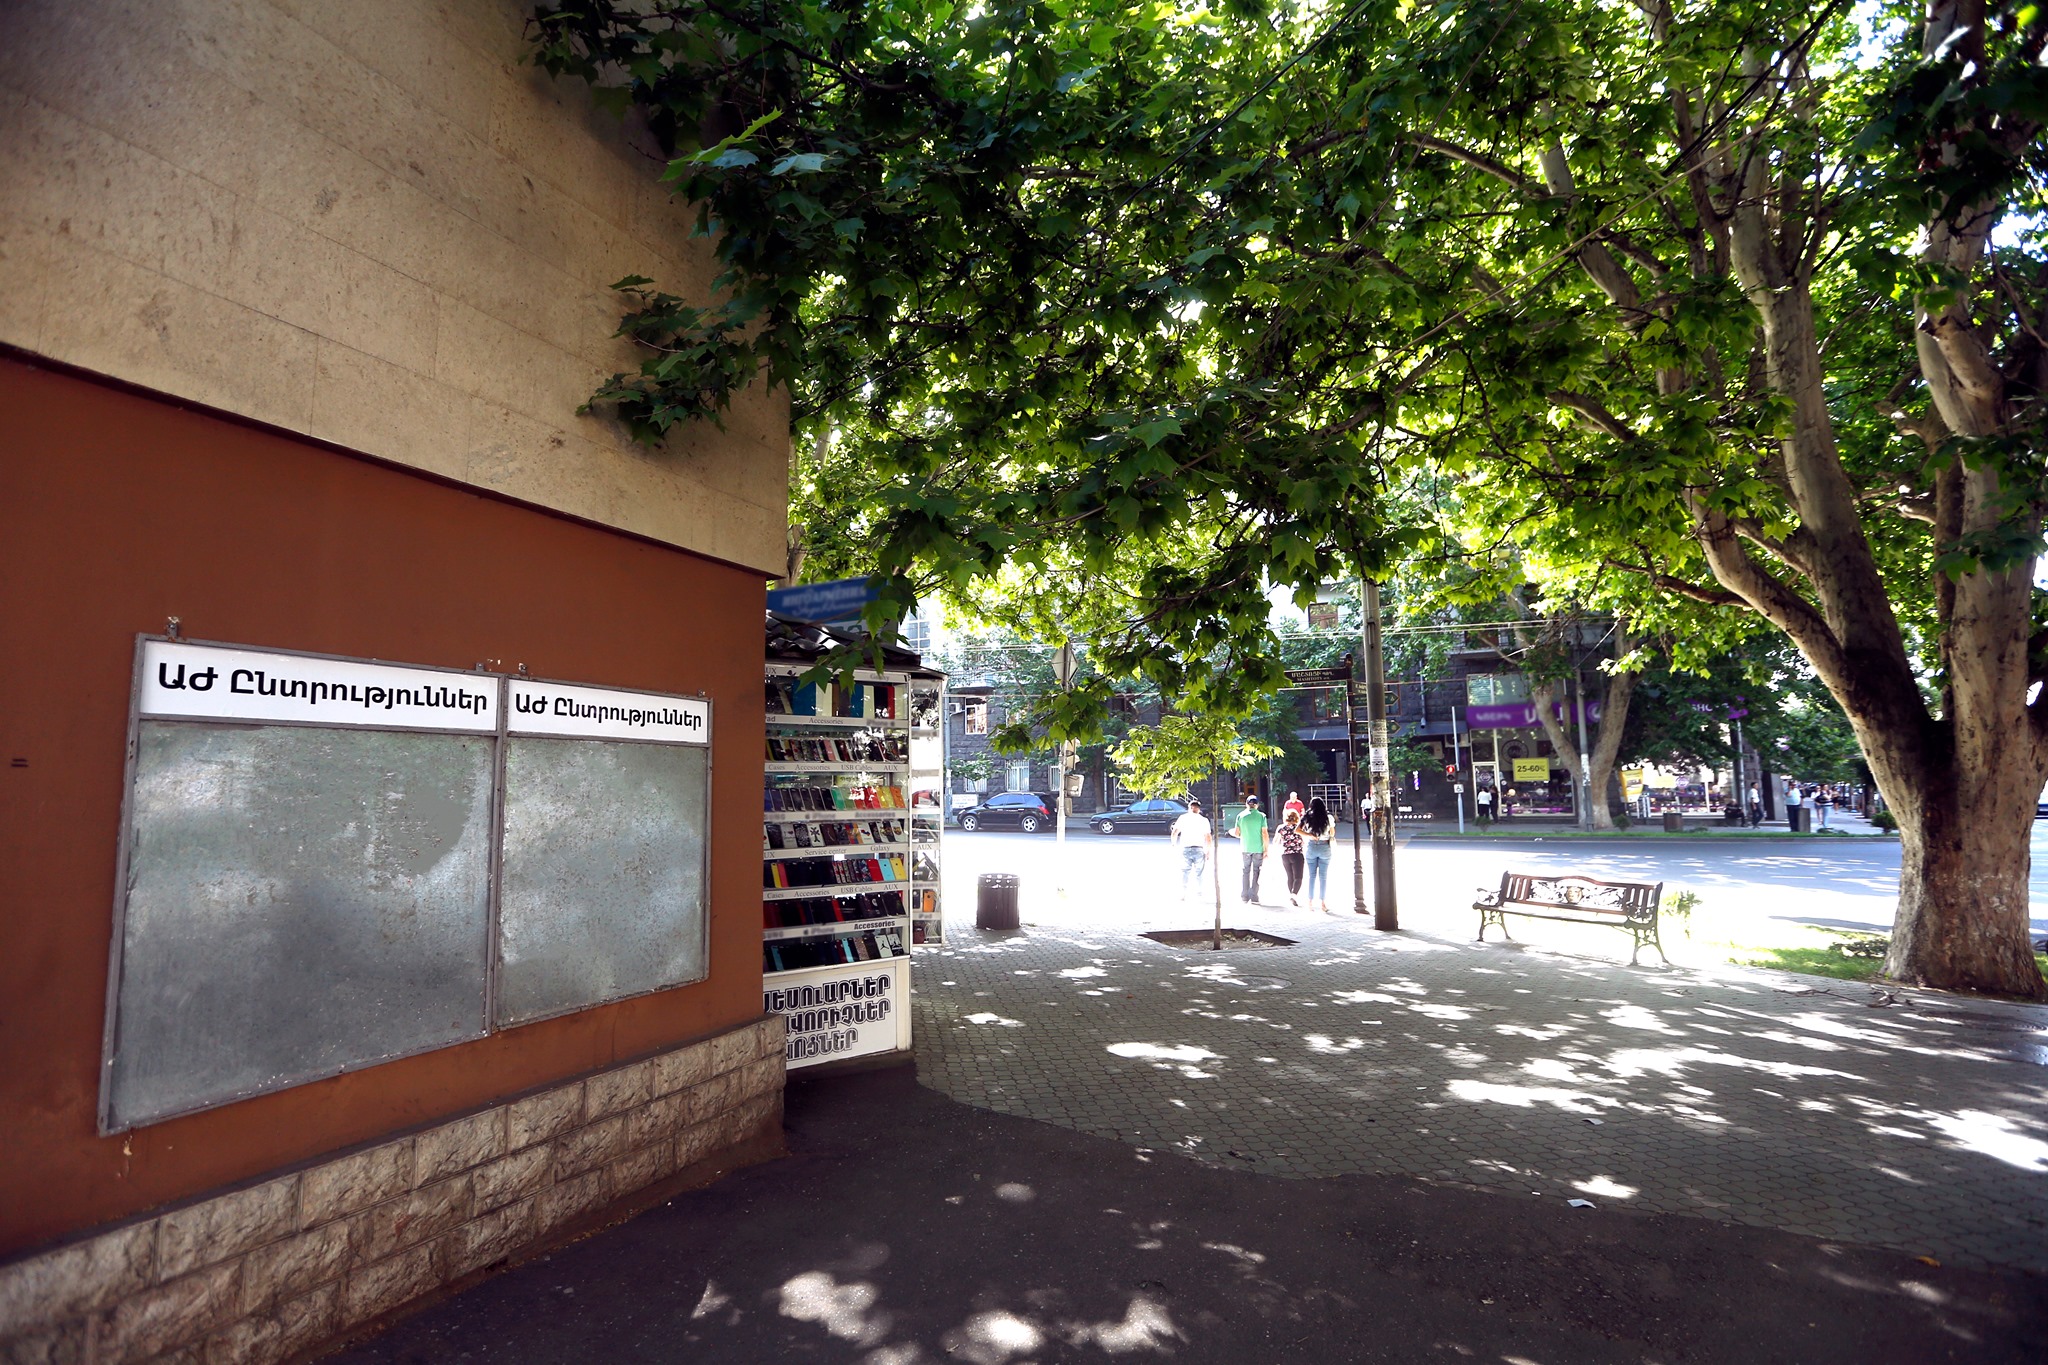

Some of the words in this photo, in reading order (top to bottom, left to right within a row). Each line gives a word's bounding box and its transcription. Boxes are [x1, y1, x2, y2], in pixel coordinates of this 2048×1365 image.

[159, 662, 219, 692] ԱԺ
[230, 669, 488, 715] Ընտրություններ
[515, 693, 548, 715] ԱԺ
[554, 697, 702, 731] Ընտրություններ
[808, 717, 844, 725] Accessories
[804, 848, 828, 856] Service
[829, 847, 847, 855] center
[870, 844, 891, 853] Galaxy
[767, 891, 784, 899] Cases
[794, 889, 830, 898] Accessories
[840, 886, 854, 894] USB
[854, 885, 873, 893] Cables
[853, 920, 896, 930] Accessories
[786, 998, 891, 1036] ՎՈՐԻՉՆԵՐ
